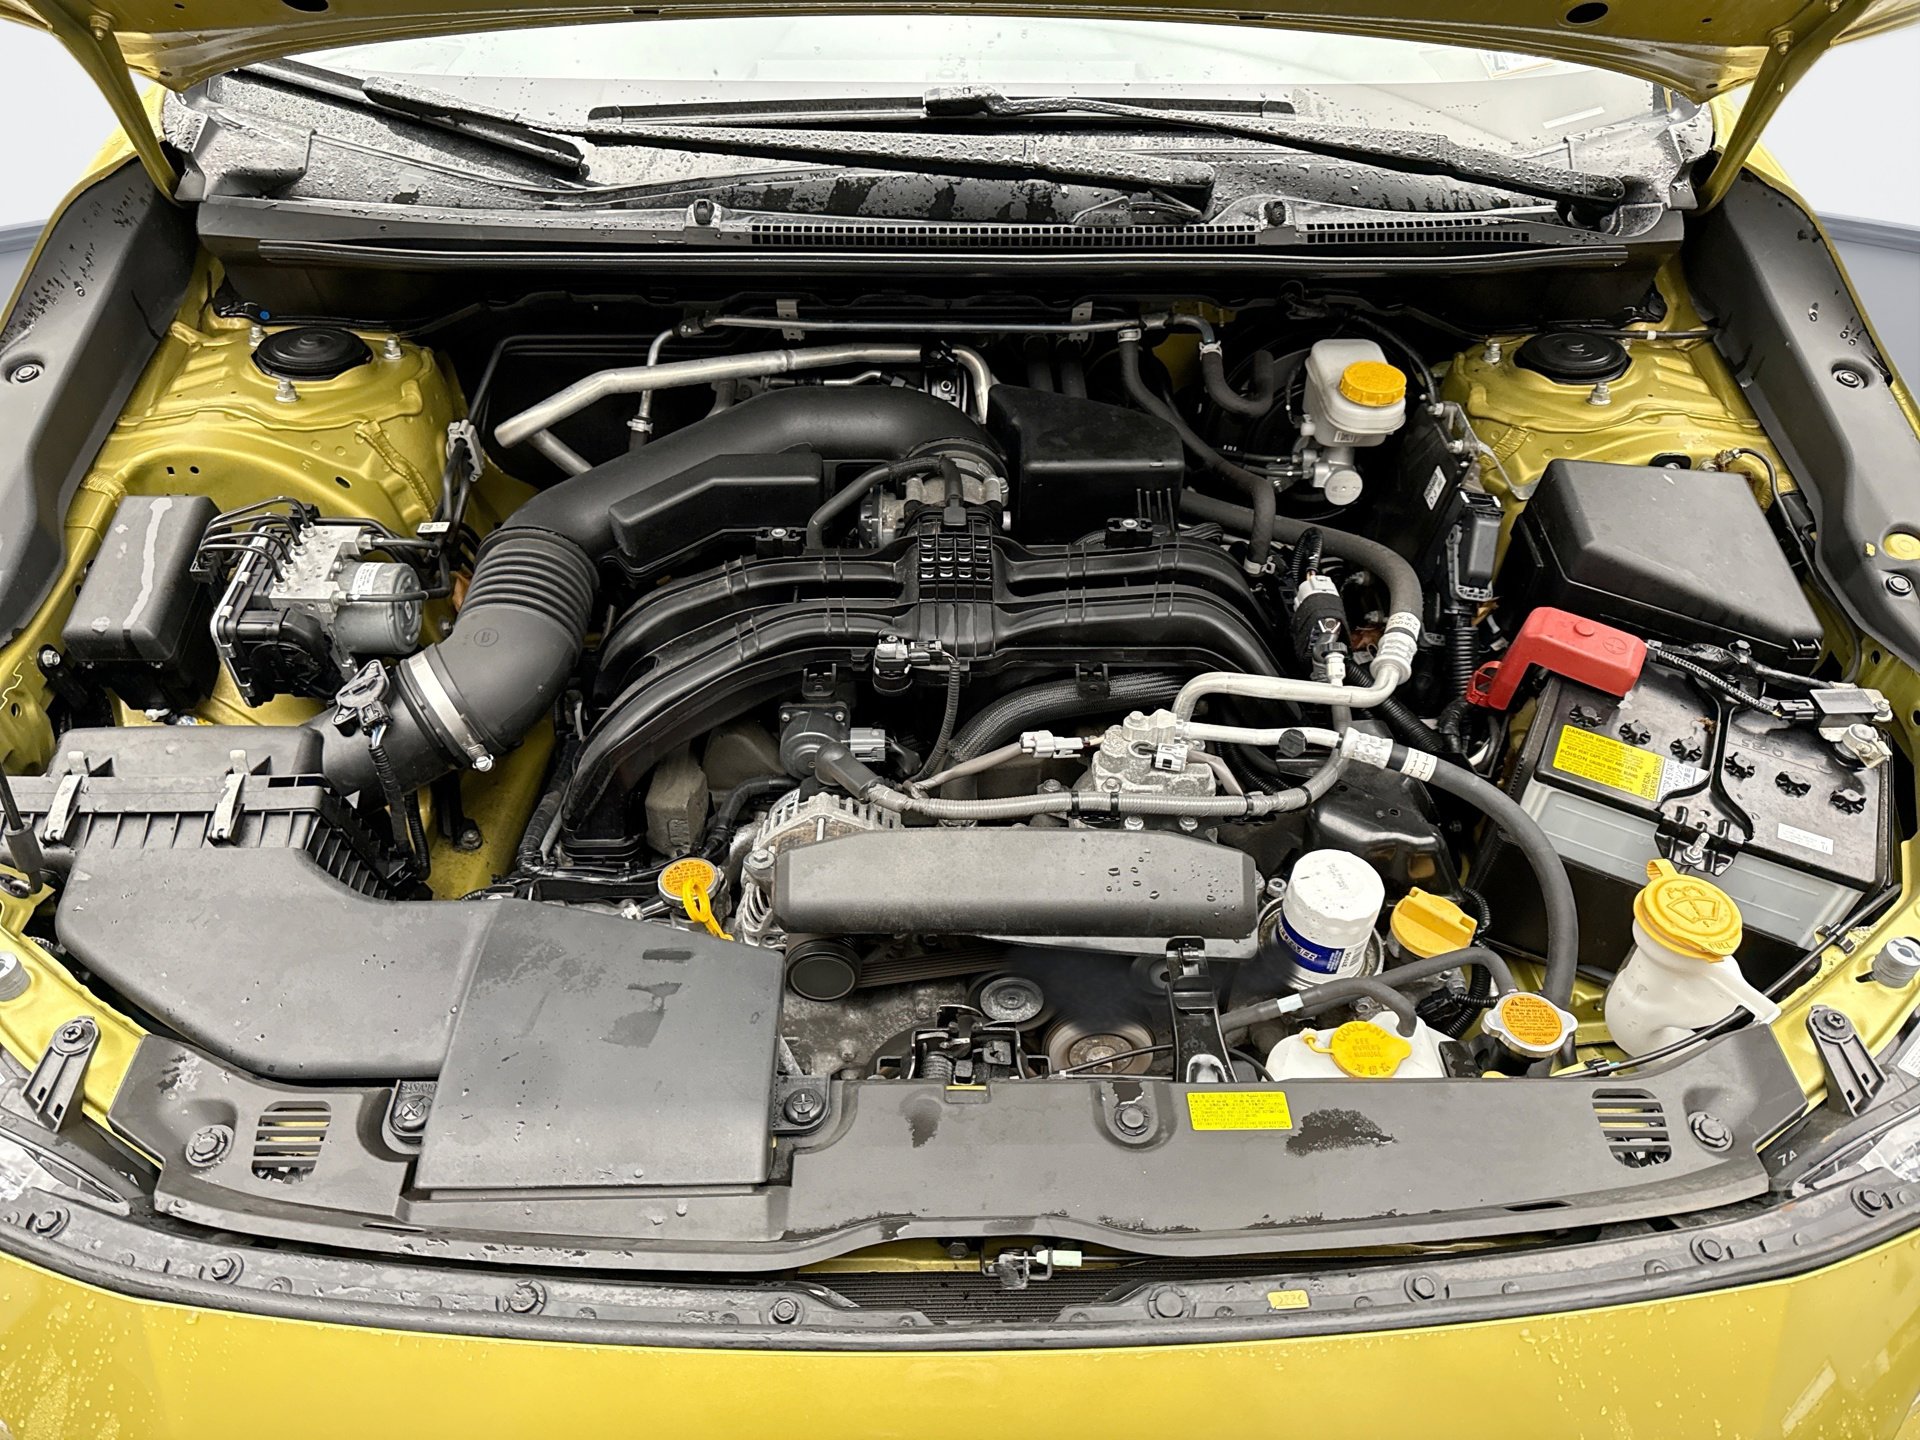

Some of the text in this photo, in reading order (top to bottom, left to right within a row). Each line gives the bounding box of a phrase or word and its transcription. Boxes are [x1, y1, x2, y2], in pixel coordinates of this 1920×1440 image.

[1565, 726, 1594, 740] DANGER
[1559, 748, 1588, 762] POISON
[1336, 1023, 1389, 1042] COOLANT
